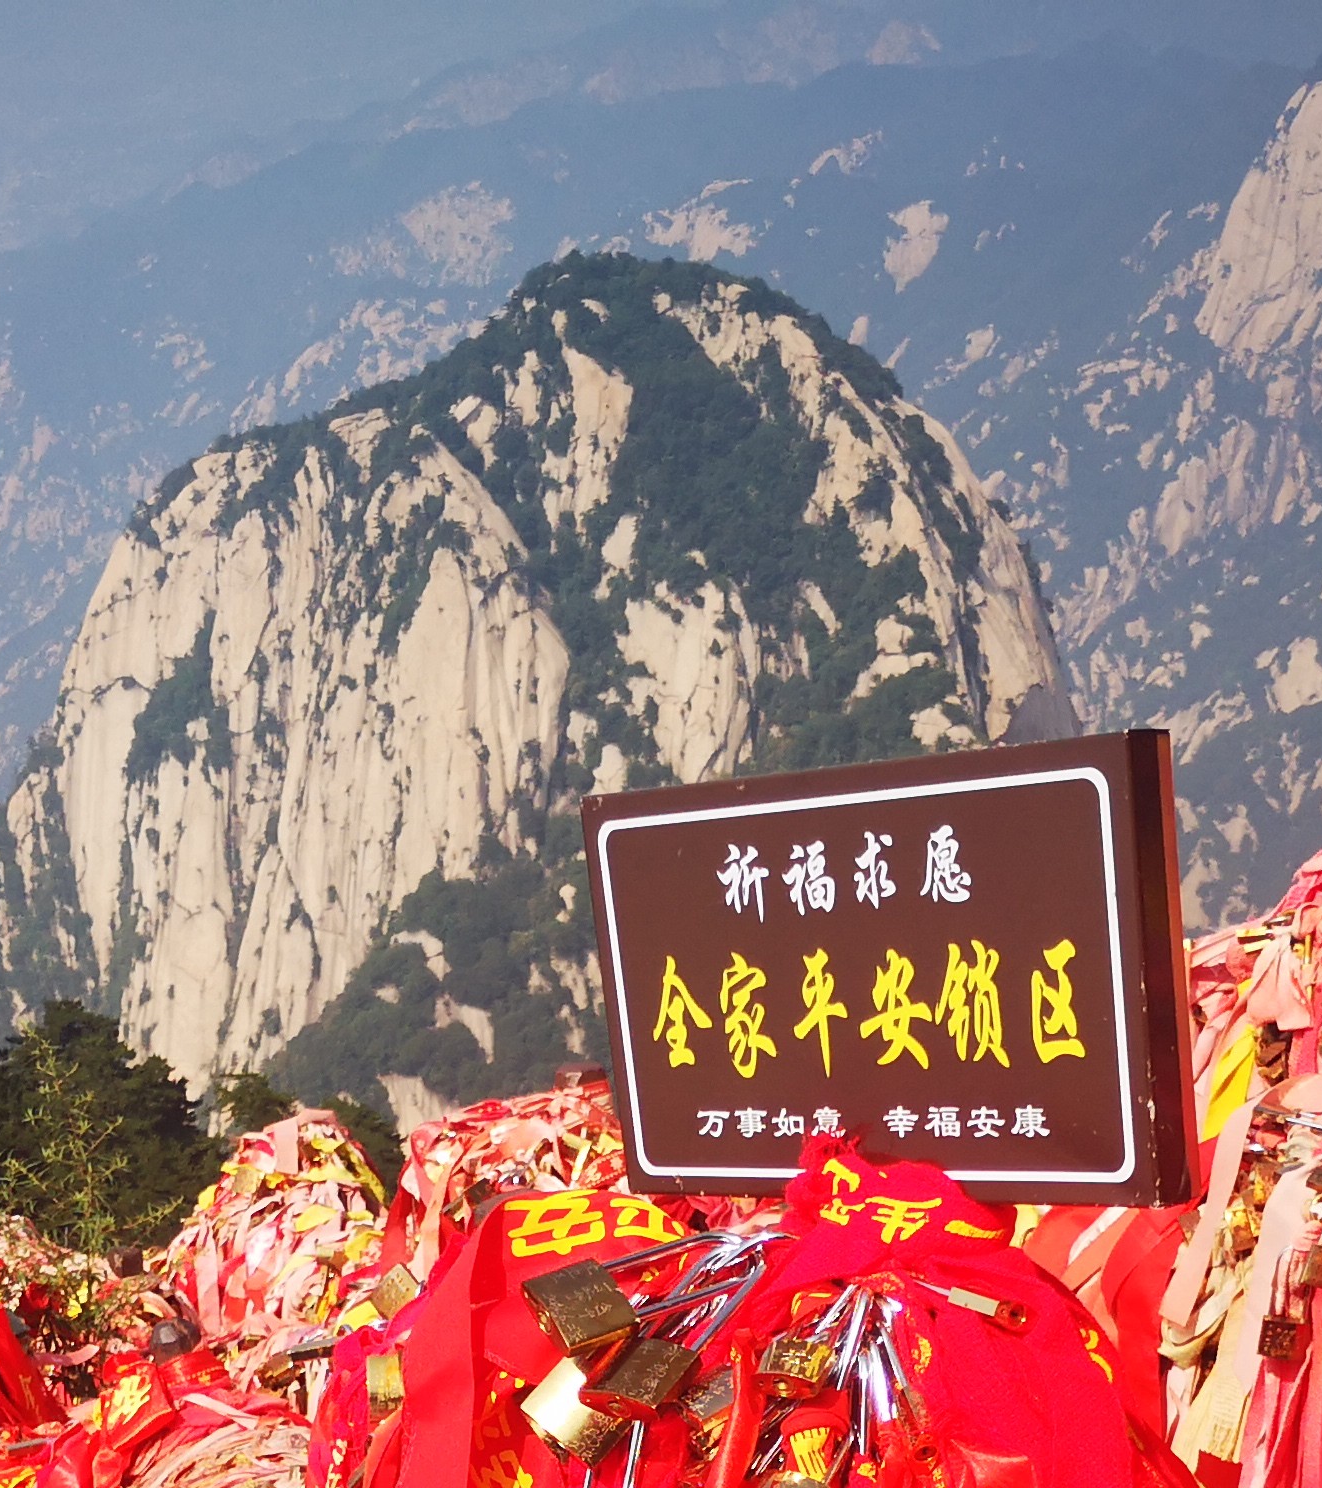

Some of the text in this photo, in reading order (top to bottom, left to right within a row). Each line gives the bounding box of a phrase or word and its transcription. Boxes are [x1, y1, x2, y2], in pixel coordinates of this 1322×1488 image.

[716, 825, 972, 922] 祈福求愿
[652, 938, 1087, 1079] 全家平安锁区
[696, 1106, 1052, 1139] 万事如意 幸福安康
